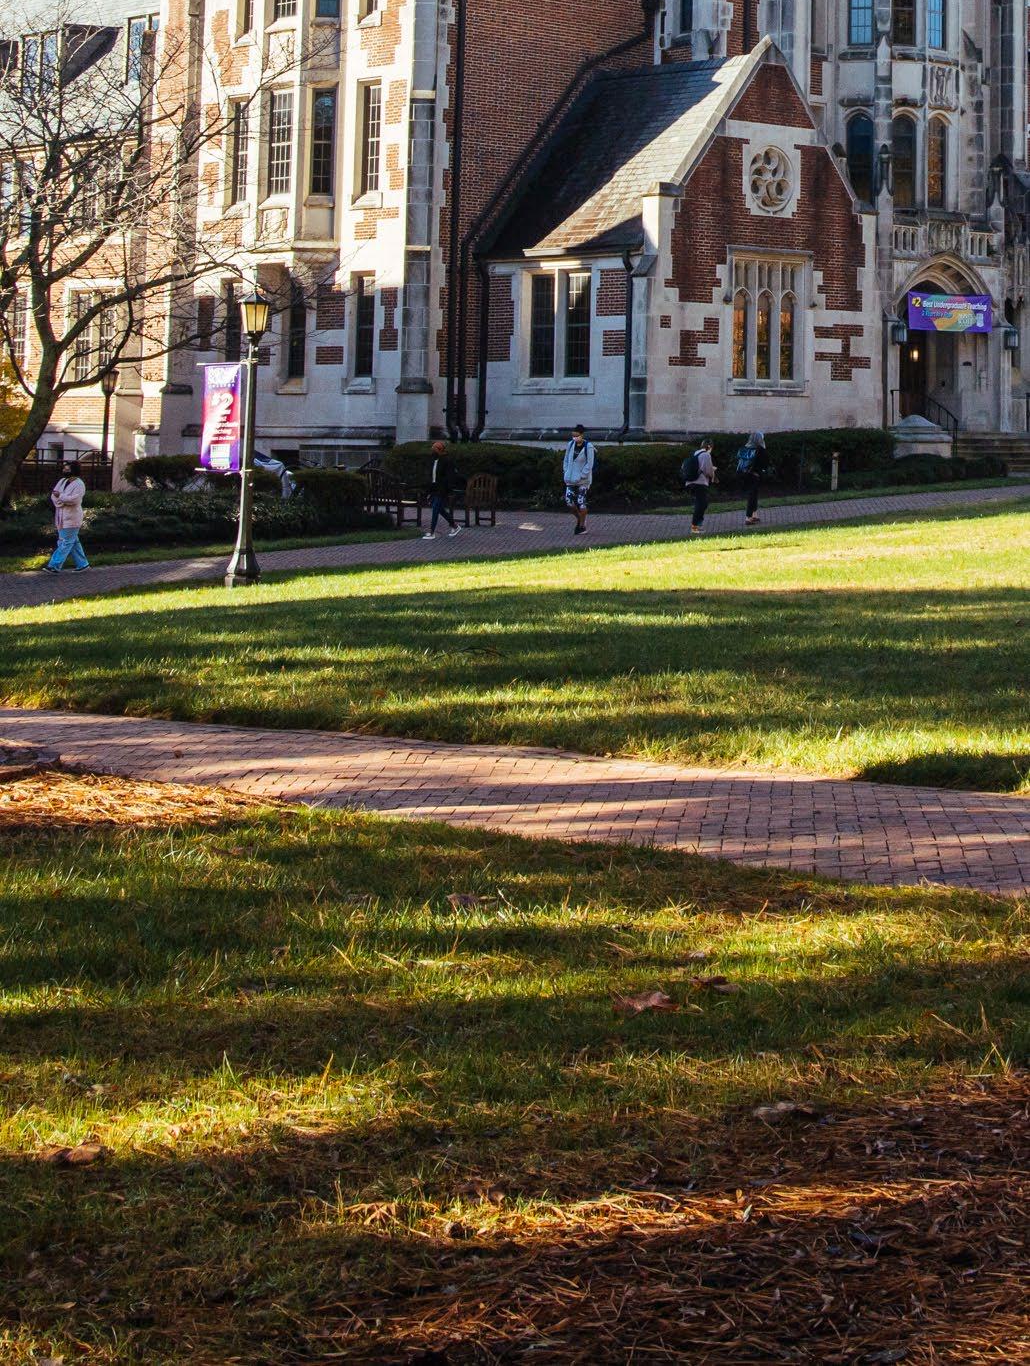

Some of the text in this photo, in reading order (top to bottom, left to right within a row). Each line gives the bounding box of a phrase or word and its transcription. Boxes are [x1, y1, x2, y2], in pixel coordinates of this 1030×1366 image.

[912, 296, 987, 312] #2 Best Undergraduate Teaching
